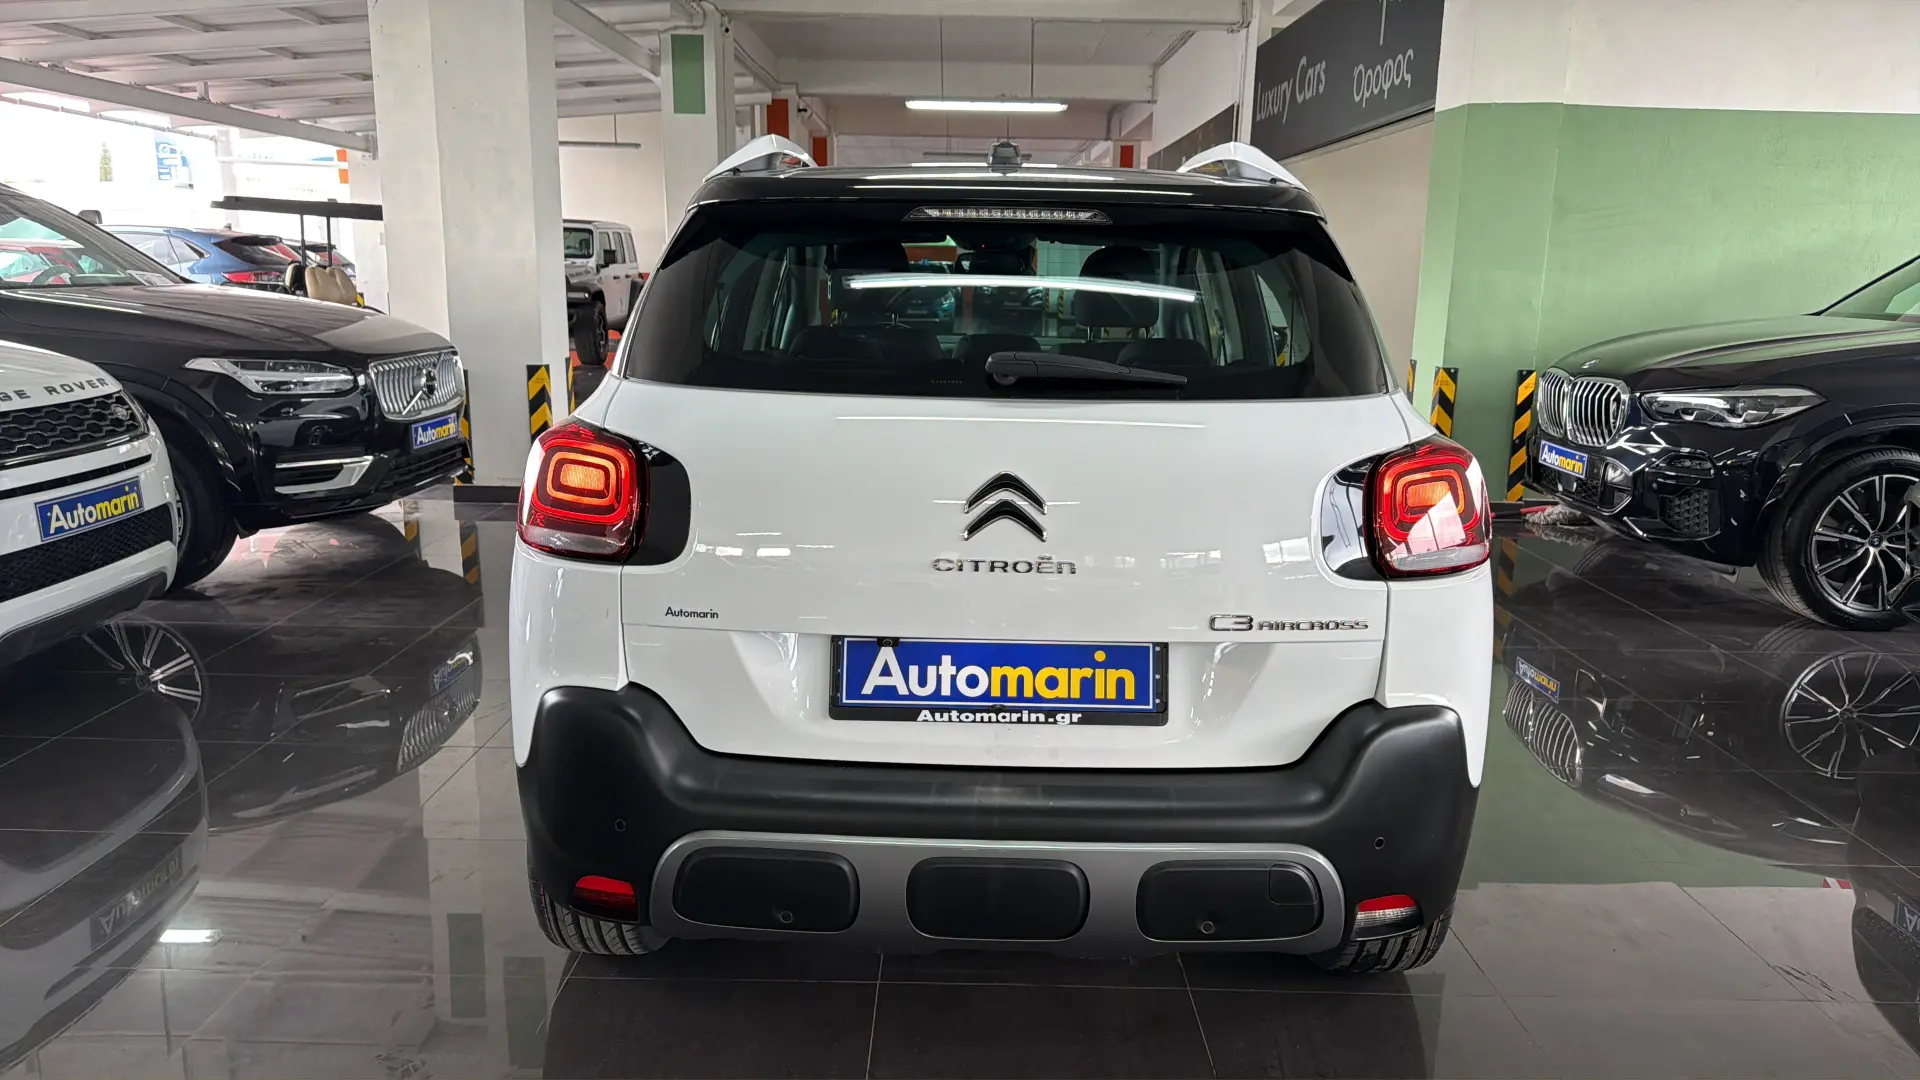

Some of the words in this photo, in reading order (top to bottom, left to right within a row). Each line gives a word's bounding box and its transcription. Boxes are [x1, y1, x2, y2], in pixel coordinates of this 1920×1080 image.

[1256, 78, 1294, 124] Luxury
[1295, 55, 1327, 104] Cars
[43, 377, 109, 396] ROVER
[417, 419, 457, 445] Automarin
[1541, 444, 1584, 474] Automarin
[49, 485, 140, 534] Automarin
[664, 606, 719, 619] Automarin
[1209, 613, 1254, 632] C3
[1258, 619, 1369, 631] AIRCROSS
[861, 646, 1136, 700] Automarin
[916, 708, 1083, 725] Automarin.gr
